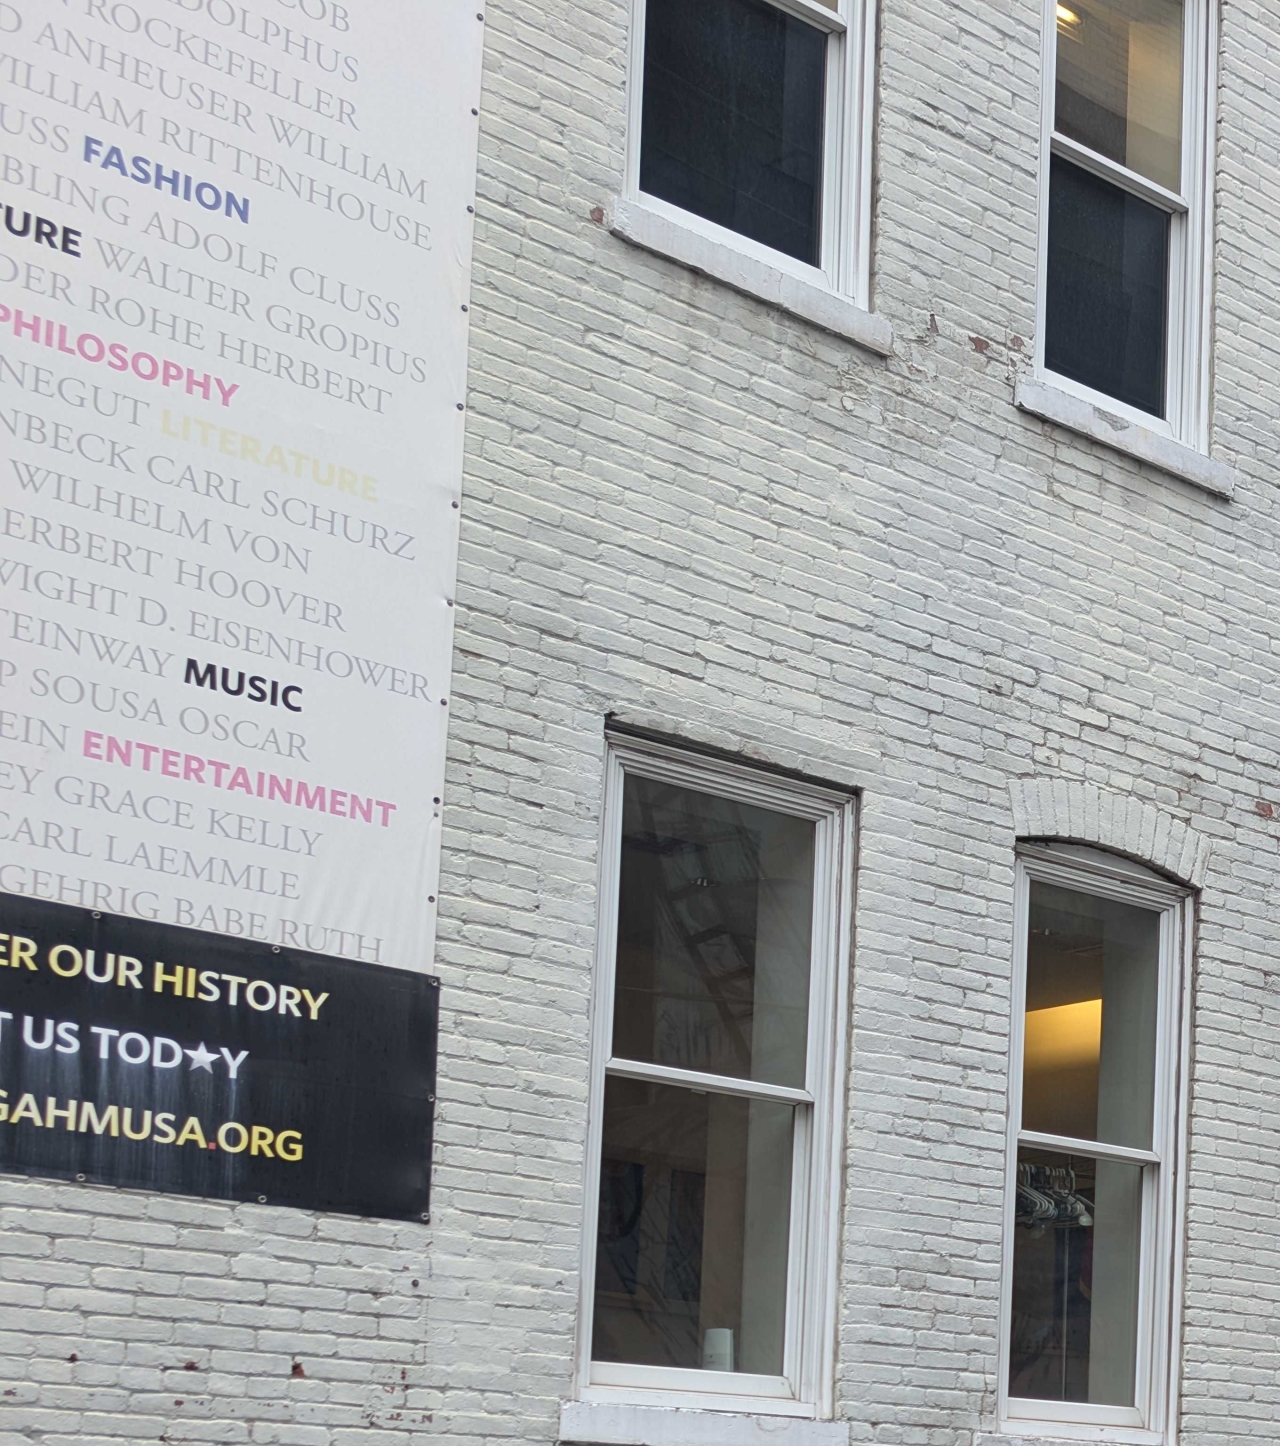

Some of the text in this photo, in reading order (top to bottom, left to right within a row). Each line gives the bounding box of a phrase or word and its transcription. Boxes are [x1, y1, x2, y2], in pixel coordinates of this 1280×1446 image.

[33, 22, 256, 134] ANHEUSER
[265, 112, 429, 206] WILLIAM
[85, 0, 360, 131] ROCKEFELLER
[0, 53, 432, 251] ILLIAM RITTENHOUSE
[82, 135, 250, 224] FASHION
[0, 204, 427, 383] URE WALTER GROPIUS
[141, 211, 278, 280] ADOLF
[289, 266, 400, 328] CLUSS
[87, 285, 206, 350] ROHE
[216, 331, 393, 415] HERBERT
[160, 408, 378, 503] LITERATURE
[9, 458, 312, 575] WILHELM VON
[146, 455, 250, 509] CARL
[261, 490, 415, 561] SCHURZ
[174, 557, 347, 632] HOOVER
[136, 596, 175, 632] D.
[187, 609, 432, 703] EISENHOWER
[184, 657, 303, 713] MUSIC
[29, 668, 168, 727] SOUSA
[179, 706, 311, 763] OSCAR
[54, 775, 195, 830] GRACE
[207, 807, 324, 857] KELLY
[82, 729, 397, 828] ENTERTAINMENT
[0, 864, 384, 963] GEHRIG BABE RUTH
[104, 833, 300, 900] LAEMMLE
[49, 944, 143, 989] OUR
[153, 961, 330, 1020] HISTORY
[22, 1015, 81, 1054] US
